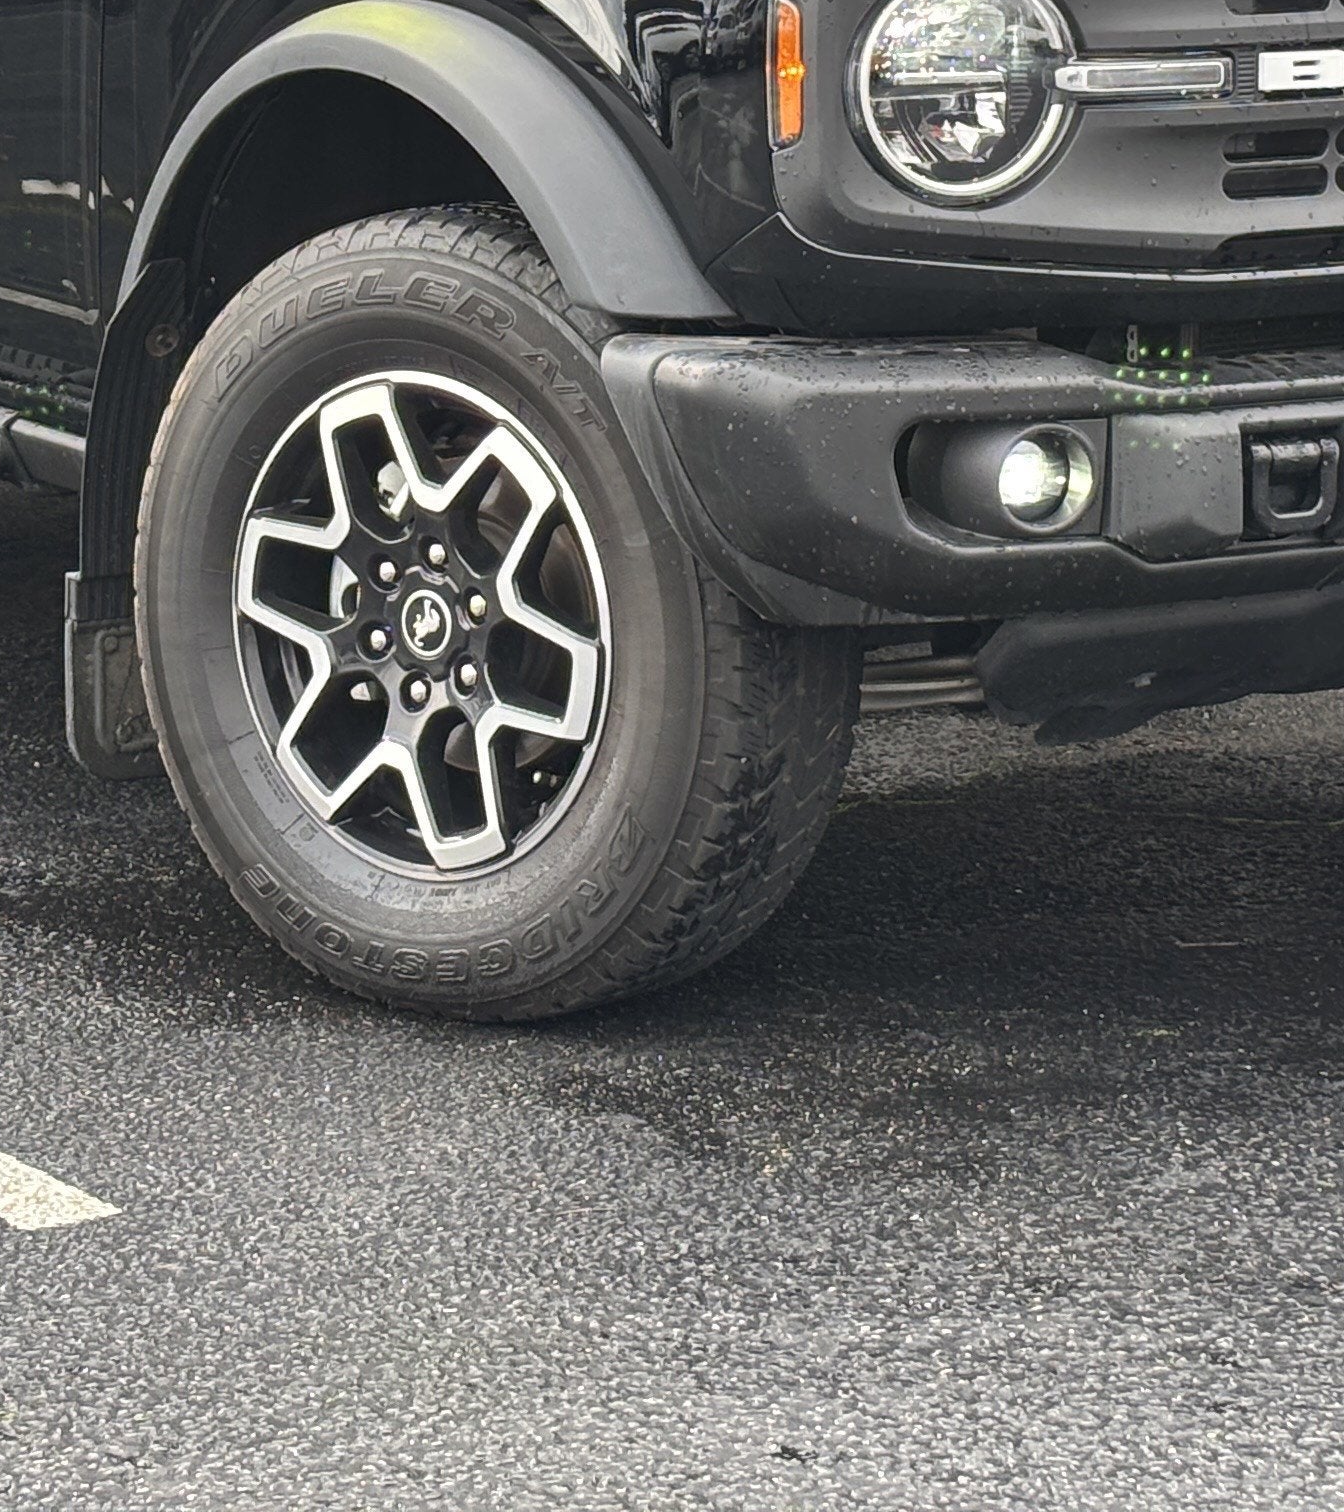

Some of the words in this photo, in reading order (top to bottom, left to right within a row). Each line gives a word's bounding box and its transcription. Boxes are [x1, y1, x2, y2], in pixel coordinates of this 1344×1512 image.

[211, 268, 517, 404] DUELER
[520, 348, 607, 433] A/T
[239, 803, 648, 983] BRIDGESTONE
